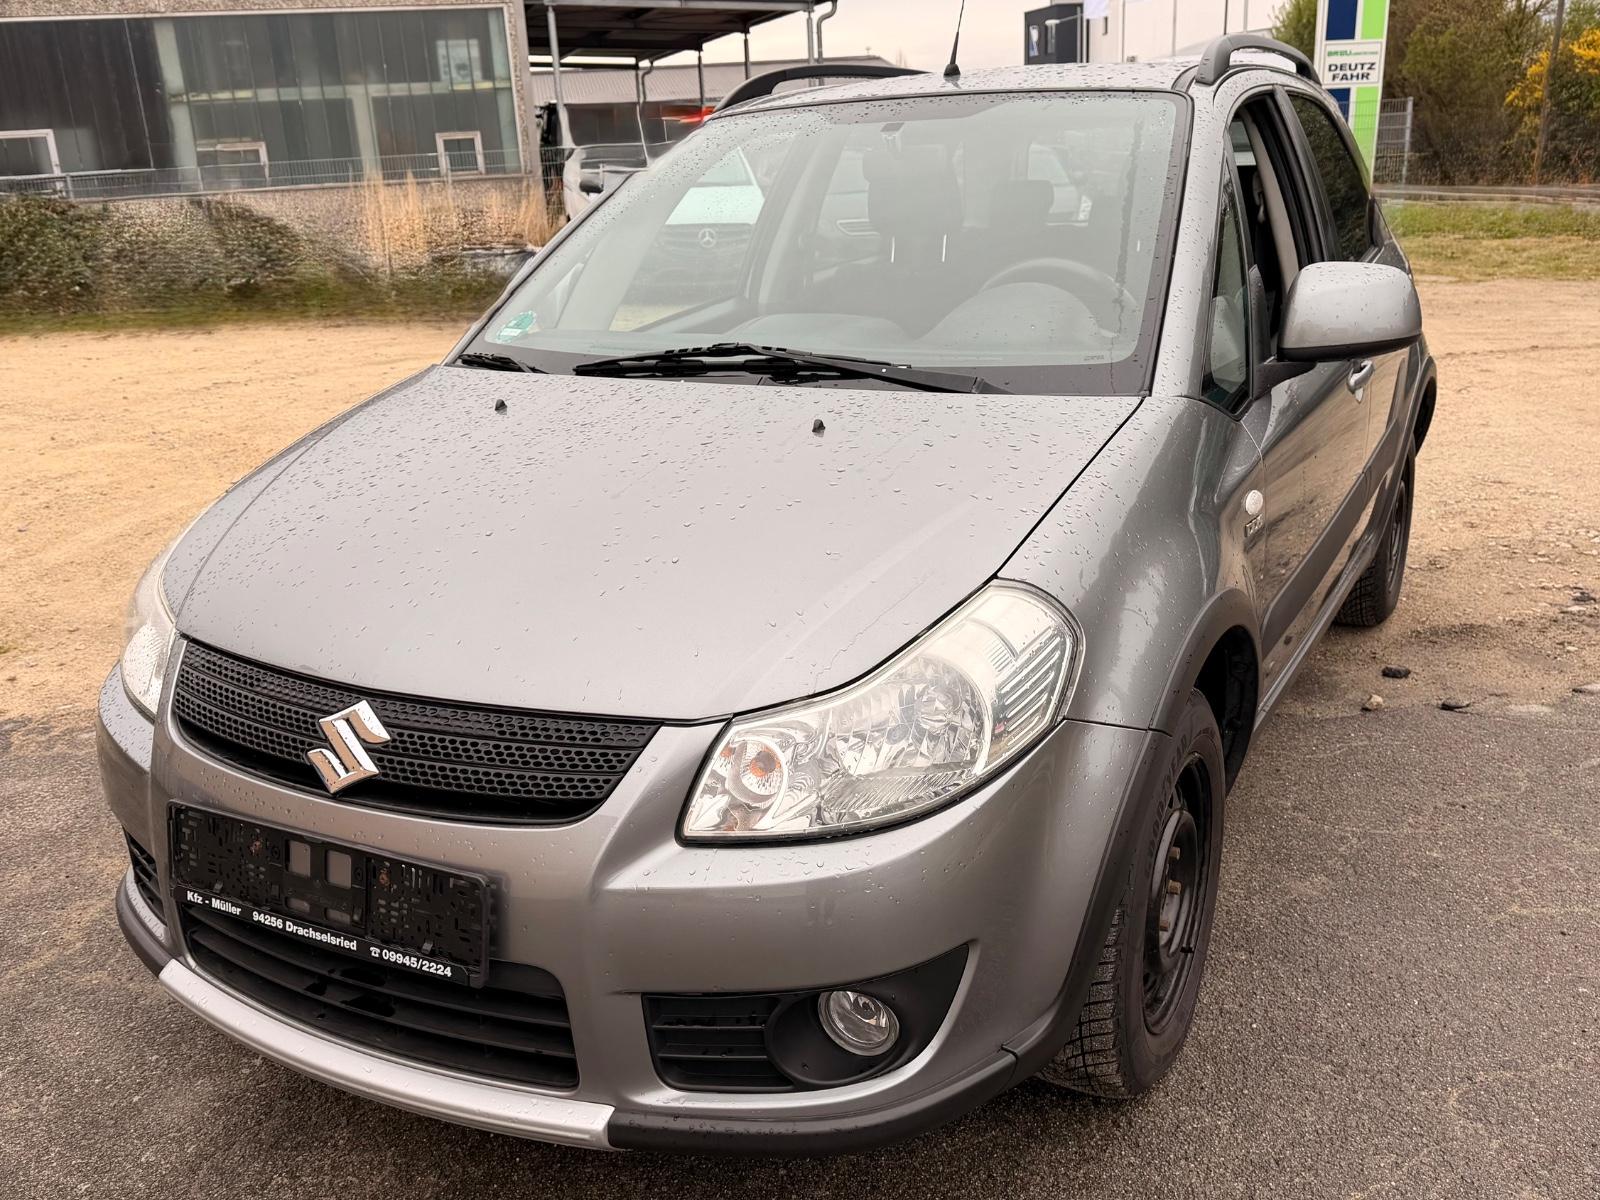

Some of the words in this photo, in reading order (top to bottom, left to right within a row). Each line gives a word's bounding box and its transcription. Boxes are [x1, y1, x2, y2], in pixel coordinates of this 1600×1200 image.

[1328, 62, 1376, 72] DEUTZ
[1332, 72, 1370, 81] FAHR
[186, 890, 203, 905] Kfz
[211, 897, 242, 916] Müller
[252, 910, 284, 930] 94256
[285, 920, 358, 951] Drachselsried
[381, 948, 453, 978] 09945/2224
